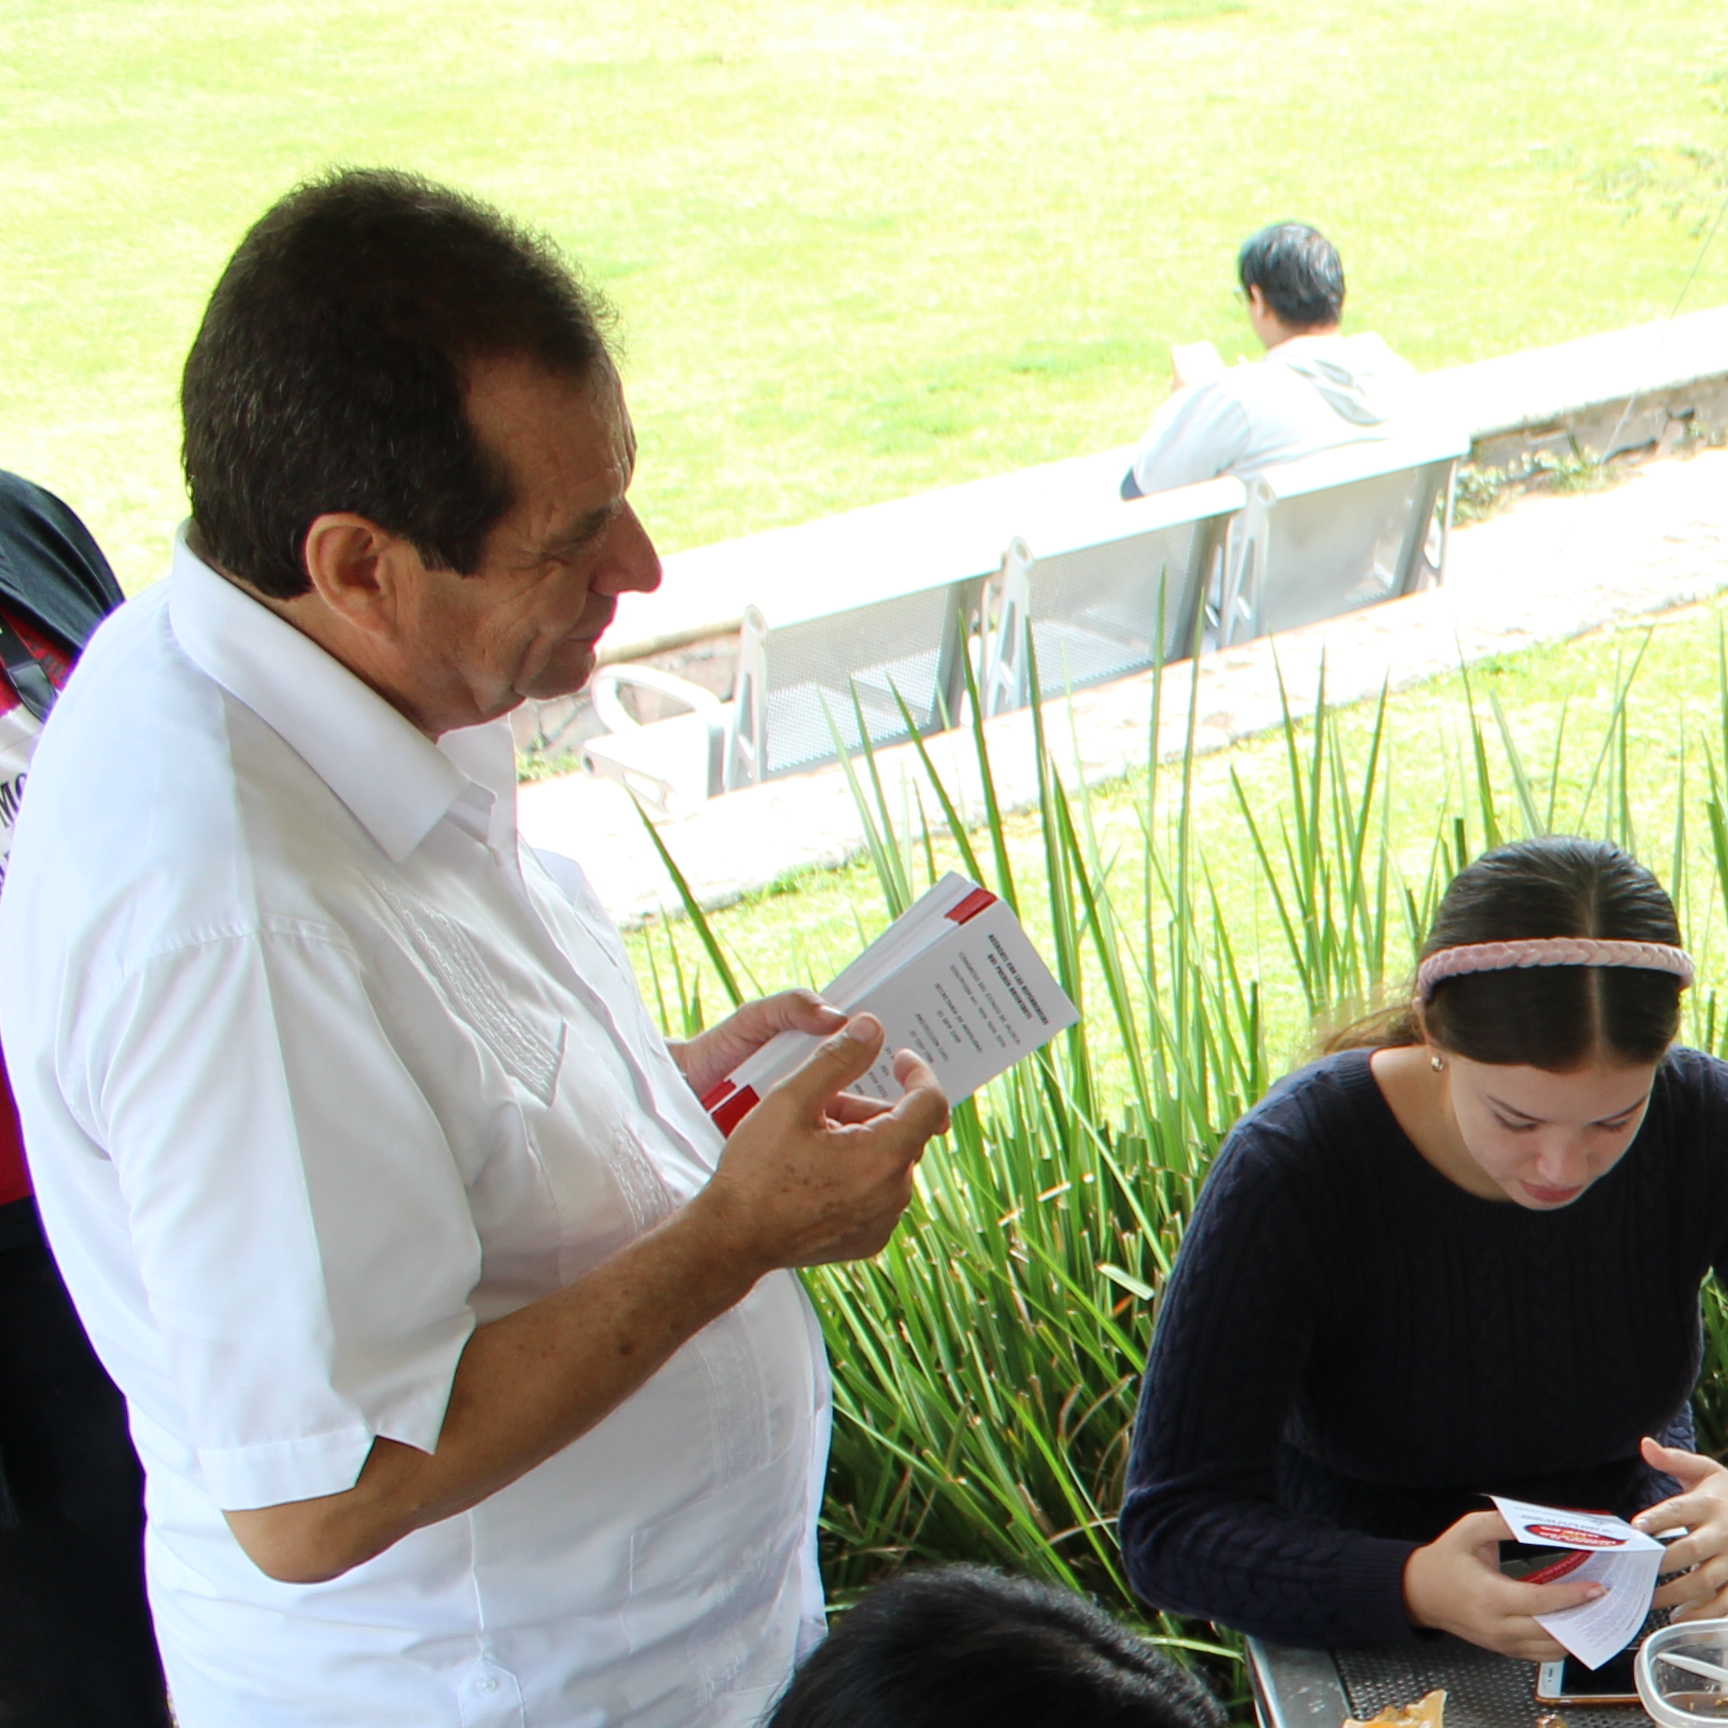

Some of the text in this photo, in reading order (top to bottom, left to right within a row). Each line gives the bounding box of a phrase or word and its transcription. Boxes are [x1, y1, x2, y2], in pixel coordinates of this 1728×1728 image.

[958, 951, 980, 982] CONGRESO
[985, 992, 1001, 1014] ESTADO
[994, 965, 1012, 988] PUEDEN
[1008, 986, 1033, 1020] ORIENTARTE
